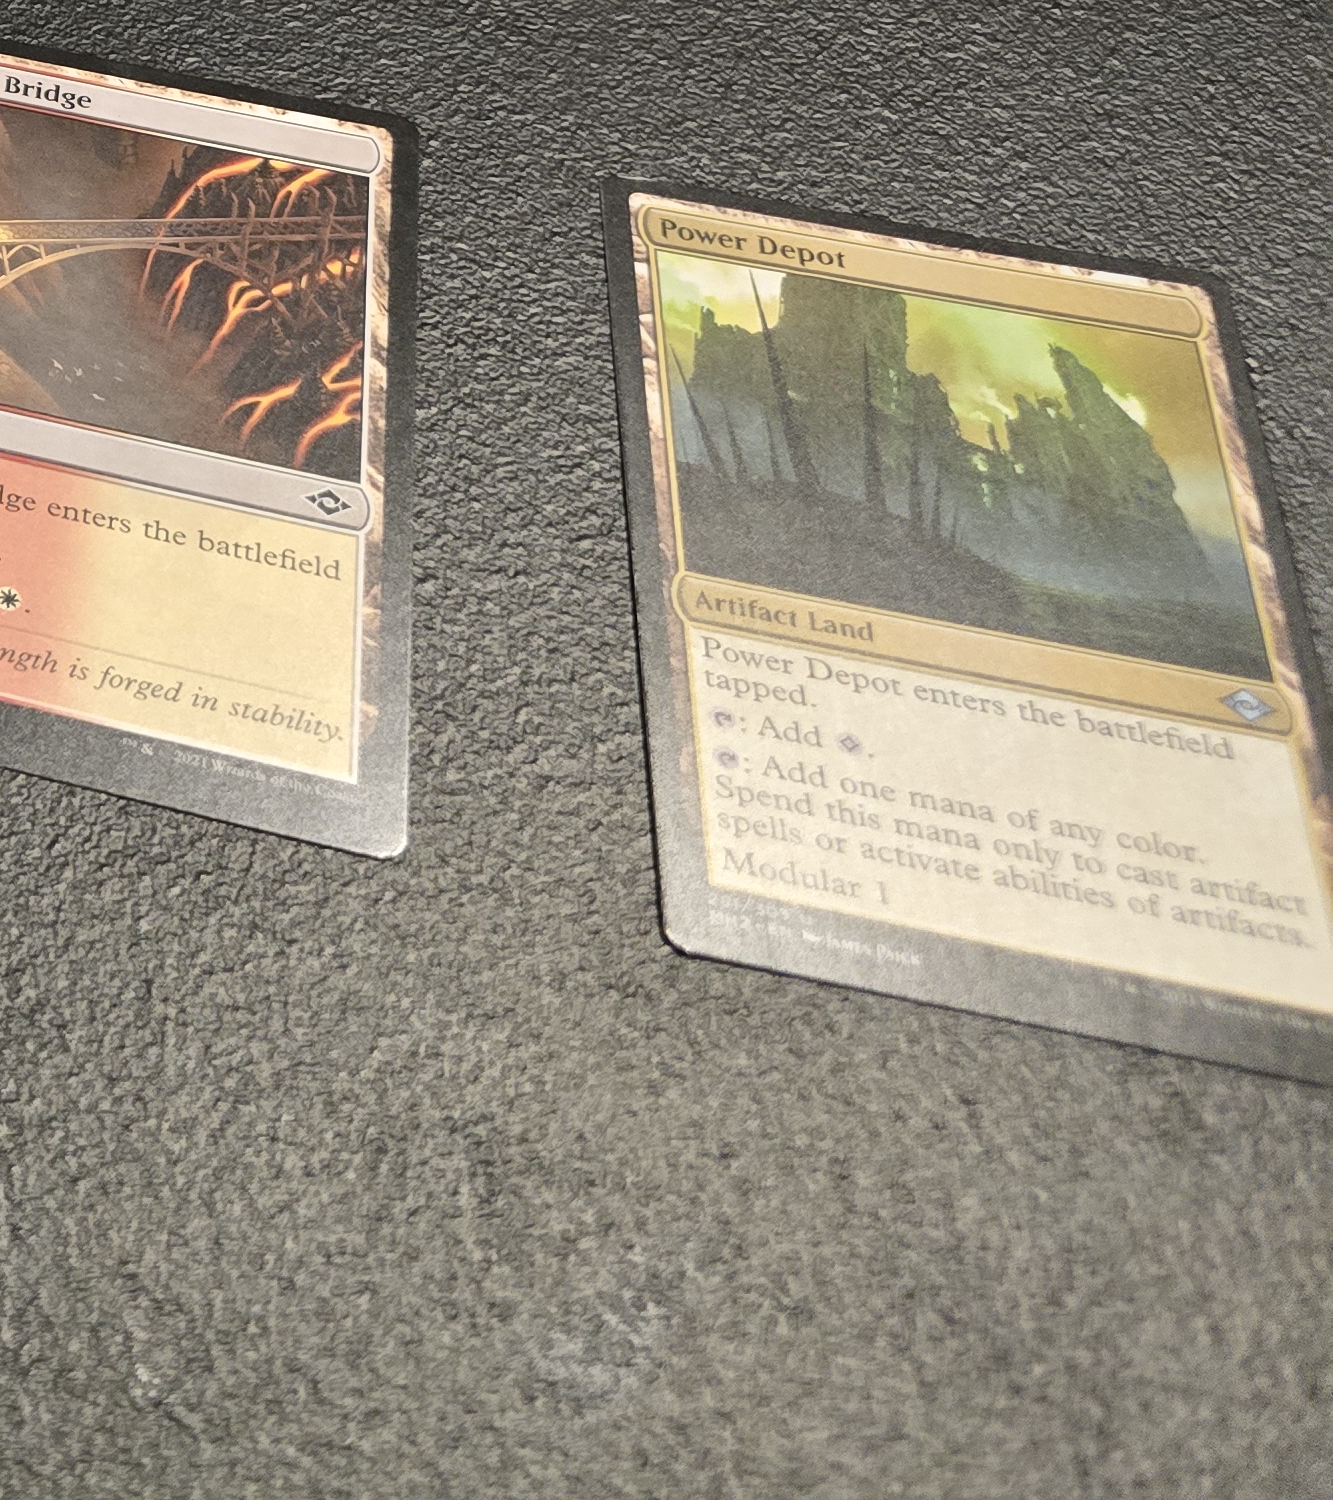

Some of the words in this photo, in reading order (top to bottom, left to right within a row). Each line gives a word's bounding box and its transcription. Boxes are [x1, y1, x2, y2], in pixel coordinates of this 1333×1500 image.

[4, 75, 92, 113] Bridge
[658, 217, 747, 251] Power
[757, 234, 847, 272] Depot
[46, 499, 131, 534] enters
[142, 518, 187, 547] the
[197, 530, 340, 581] battlefield
[693, 589, 797, 627] Artifact
[807, 611, 874, 643] Land
[68, 658, 89, 681] is
[93, 663, 180, 709] forged
[192, 688, 218, 713] in
[228, 695, 344, 748] stability.
[701, 636, 794, 676] Power
[805, 657, 903, 703] Depot
[913, 681, 1007, 718] enters
[1016, 698, 1067, 729] the
[1076, 710, 1235, 763] battlefield
[704, 669, 819, 713] tapped.
[756, 715, 823, 749] Add
[760, 756, 829, 791] Add
[839, 776, 897, 804] one
[908, 790, 994, 824] mana
[1004, 804, 1040, 833] of
[1049, 818, 1105, 853] any
[1114, 827, 1207, 866] color.
[720, 848, 863, 901] Modular
[875, 881, 891, 906] 1
